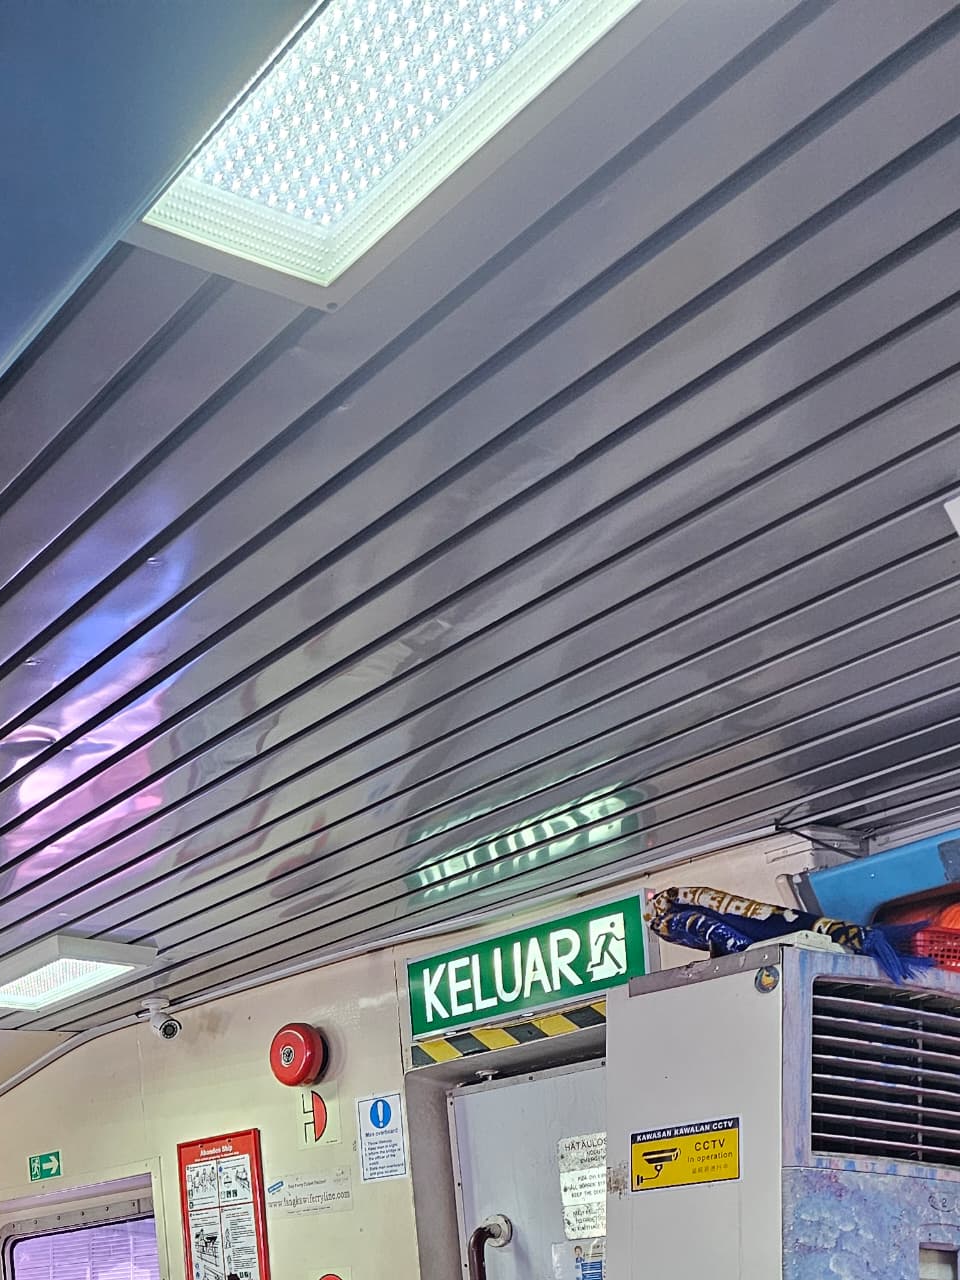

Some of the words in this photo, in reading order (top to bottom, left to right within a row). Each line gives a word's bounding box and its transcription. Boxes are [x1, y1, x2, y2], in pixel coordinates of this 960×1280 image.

[423, 928, 583, 1023] KELUAR
[636, 1129, 672, 1142] KAWASAN
[674, 1124, 710, 1136] KAWALAN
[712, 1120, 734, 1130] CCTV
[694, 1138, 725, 1152] CCTV
[697, 1151, 733, 1162] operation
